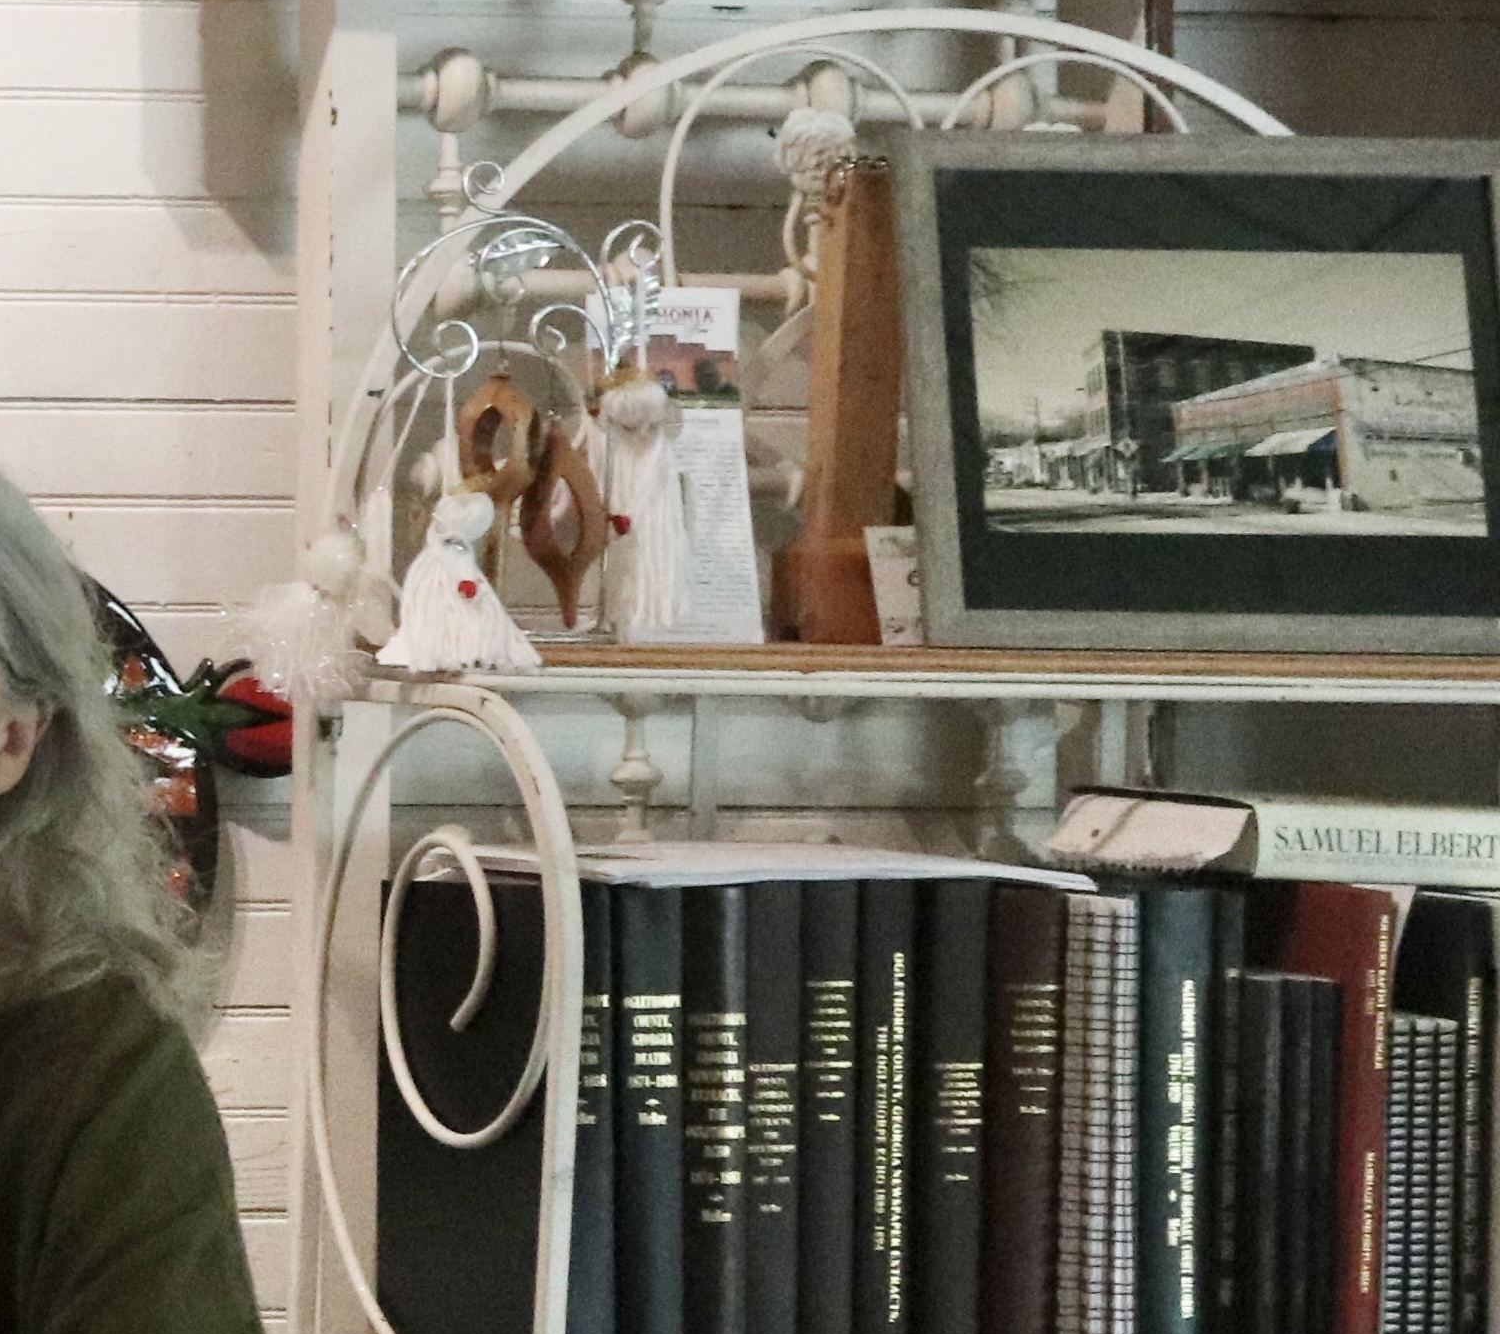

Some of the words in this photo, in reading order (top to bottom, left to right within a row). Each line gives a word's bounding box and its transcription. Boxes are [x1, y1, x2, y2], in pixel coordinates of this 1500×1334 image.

[1273, 825, 1390, 857] SAMUEL
[1396, 829, 1500, 860] ELBERT
[893, 951, 906, 1042] OGLETHORPE
[876, 1026, 889, 1050] THE
[875, 1054, 888, 1142] OGLETHORPE
[891, 1045, 904, 1103] COUNTY,
[874, 1148, 887, 1185] ECHO
[891, 1105, 903, 1168] GEORGIA
[890, 1169, 902, 1247] NEWSPAPER
